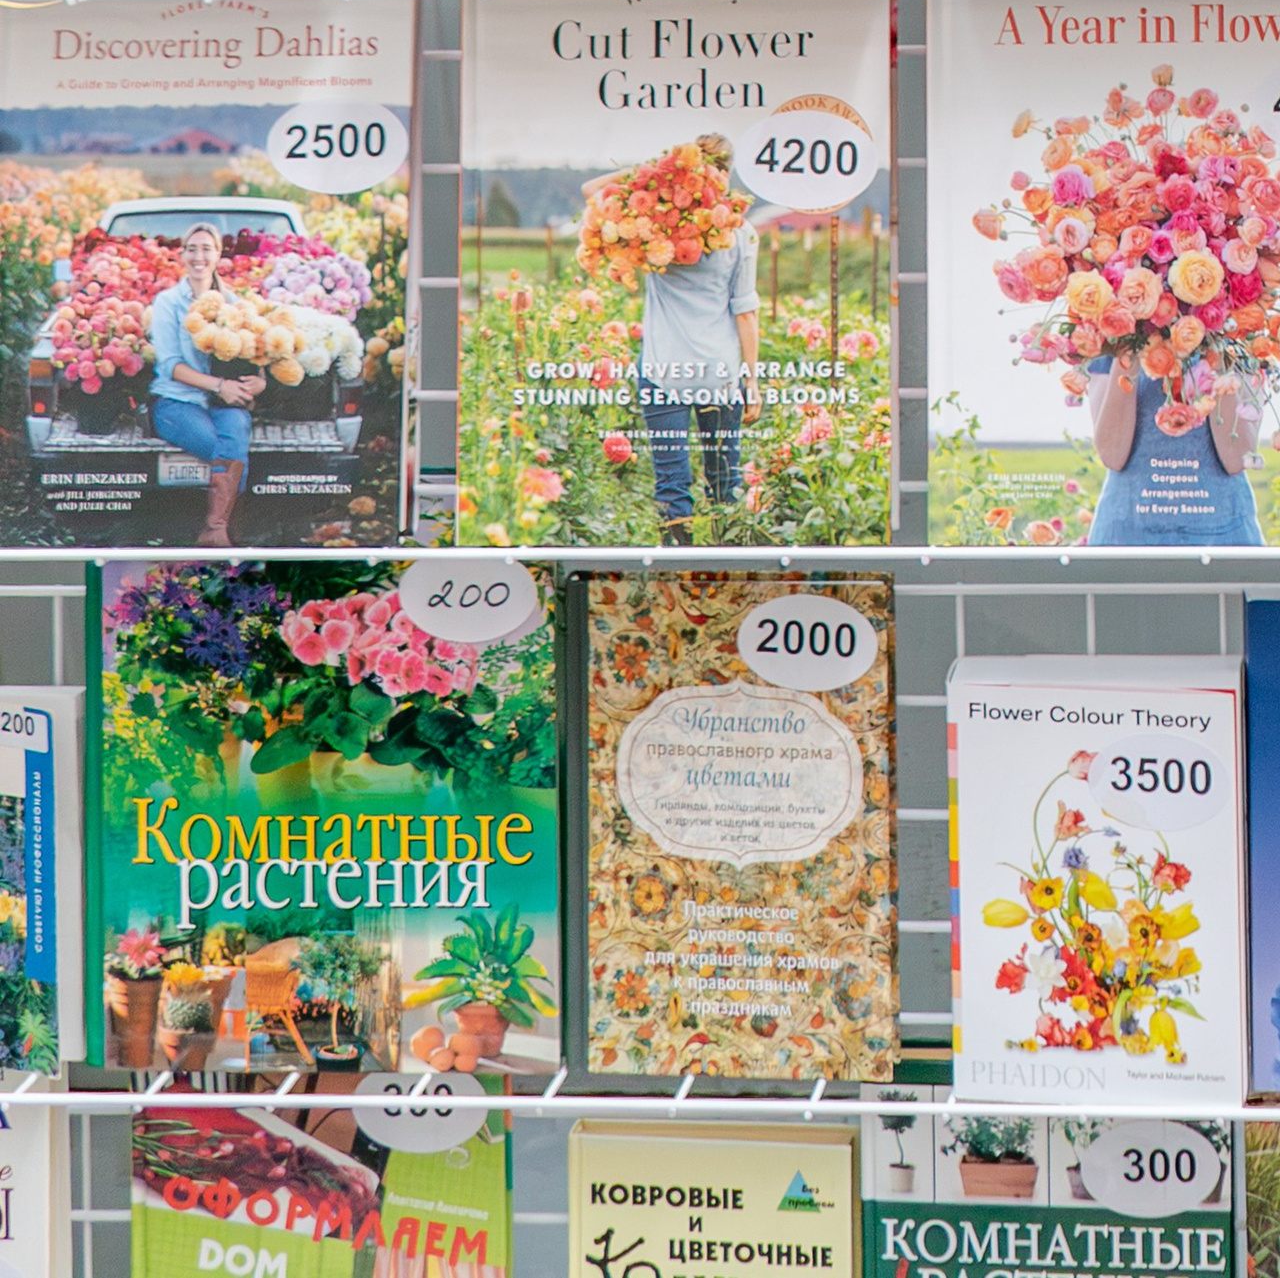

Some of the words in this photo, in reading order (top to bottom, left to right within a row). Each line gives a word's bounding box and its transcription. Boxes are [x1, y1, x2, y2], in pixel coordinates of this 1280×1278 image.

[552, 19, 633, 61] Cut
[649, 19, 812, 60] Flower
[996, 7, 1025, 45] A
[1037, 5, 1125, 45] Year
[1140, 5, 1174, 43] in
[54, 28, 242, 66] Discovering
[254, 26, 379, 61] Dahlias
[599, 69, 764, 110] Garden
[285, 122, 387, 159] 2500
[755, 138, 859, 176] 4200
[513, 388, 631, 406] STUNNING
[640, 388, 756, 405] SEASONAL
[766, 388, 860, 405] BLOOMS
[428, 582, 510, 609] 200
[757, 618, 857, 656] 2000
[968, 703, 1042, 722] Flower
[1049, 707, 1124, 726] Colour
[1131, 710, 1211, 732] Theory
[1110, 756, 1212, 795] 3500
[133, 797, 533, 866] Комнатные
[178, 856, 490, 929] растения
[1122, 1148, 1196, 1183] 300
[590, 1182, 745, 1208] КОВРОВЫЕ
[668, 1240, 834, 1267] ЦВЕТОЧНЫЕ
[880, 1218, 1227, 1273] КОМНАТНЫЕ
